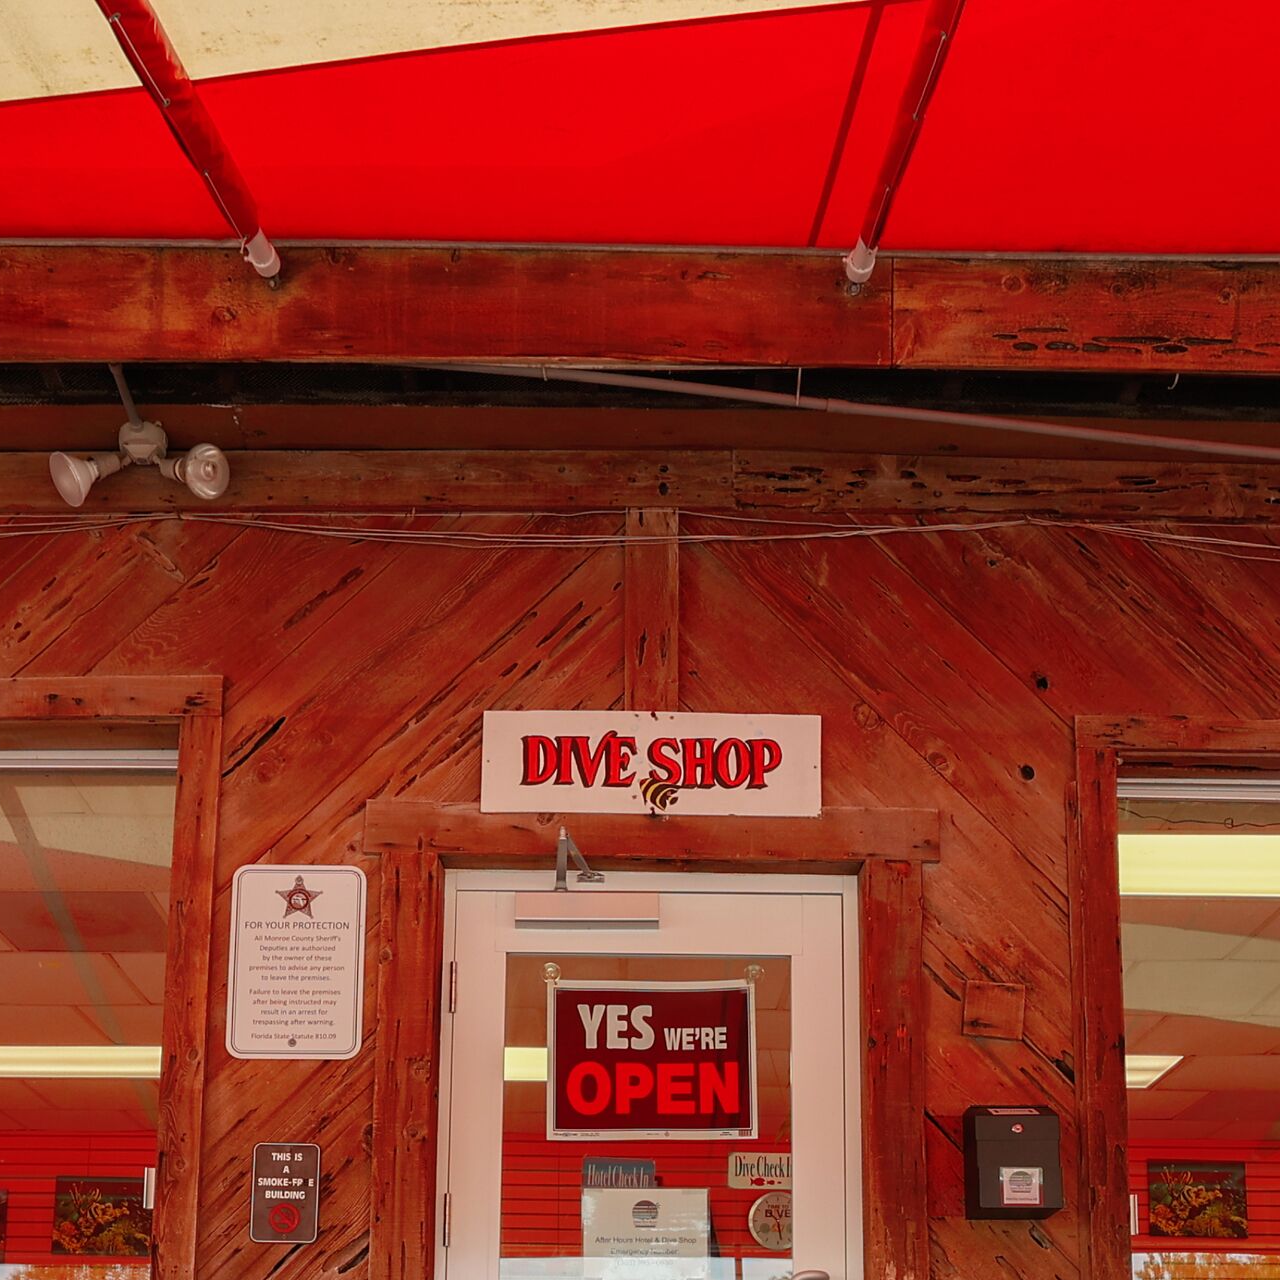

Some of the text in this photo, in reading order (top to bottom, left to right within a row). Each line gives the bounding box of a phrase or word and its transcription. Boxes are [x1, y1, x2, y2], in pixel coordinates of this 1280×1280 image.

[520, 730, 782, 790] DIVE SHOP
[244, 921, 350, 930] FOR YOUR PROTECTION
[291, 935, 314, 943] County
[260, 945, 288, 953] Deputies
[577, 1003, 727, 1051] YES WE'RE
[566, 1060, 739, 1116] OPEN
[272, 1152, 302, 1162] THIS IS
[282, 1166, 290, 1174] A
[734, 1155, 755, 1177] Dive
[756, 1155, 784, 1178] Check
[588, 1164, 611, 1186] Hotel
[612, 1165, 638, 1188] Check
[258, 1178, 314, 1187] SMOKE-FRE
[265, 1190, 305, 1200] BUILDING
[765, 1209, 791, 1218] DVE
[595, 1236, 612, 1244] After
[613, 1236, 634, 1244] Hours
[635, 1236, 651, 1244] Hotel
[679, 1237, 697, 1245] Shop
